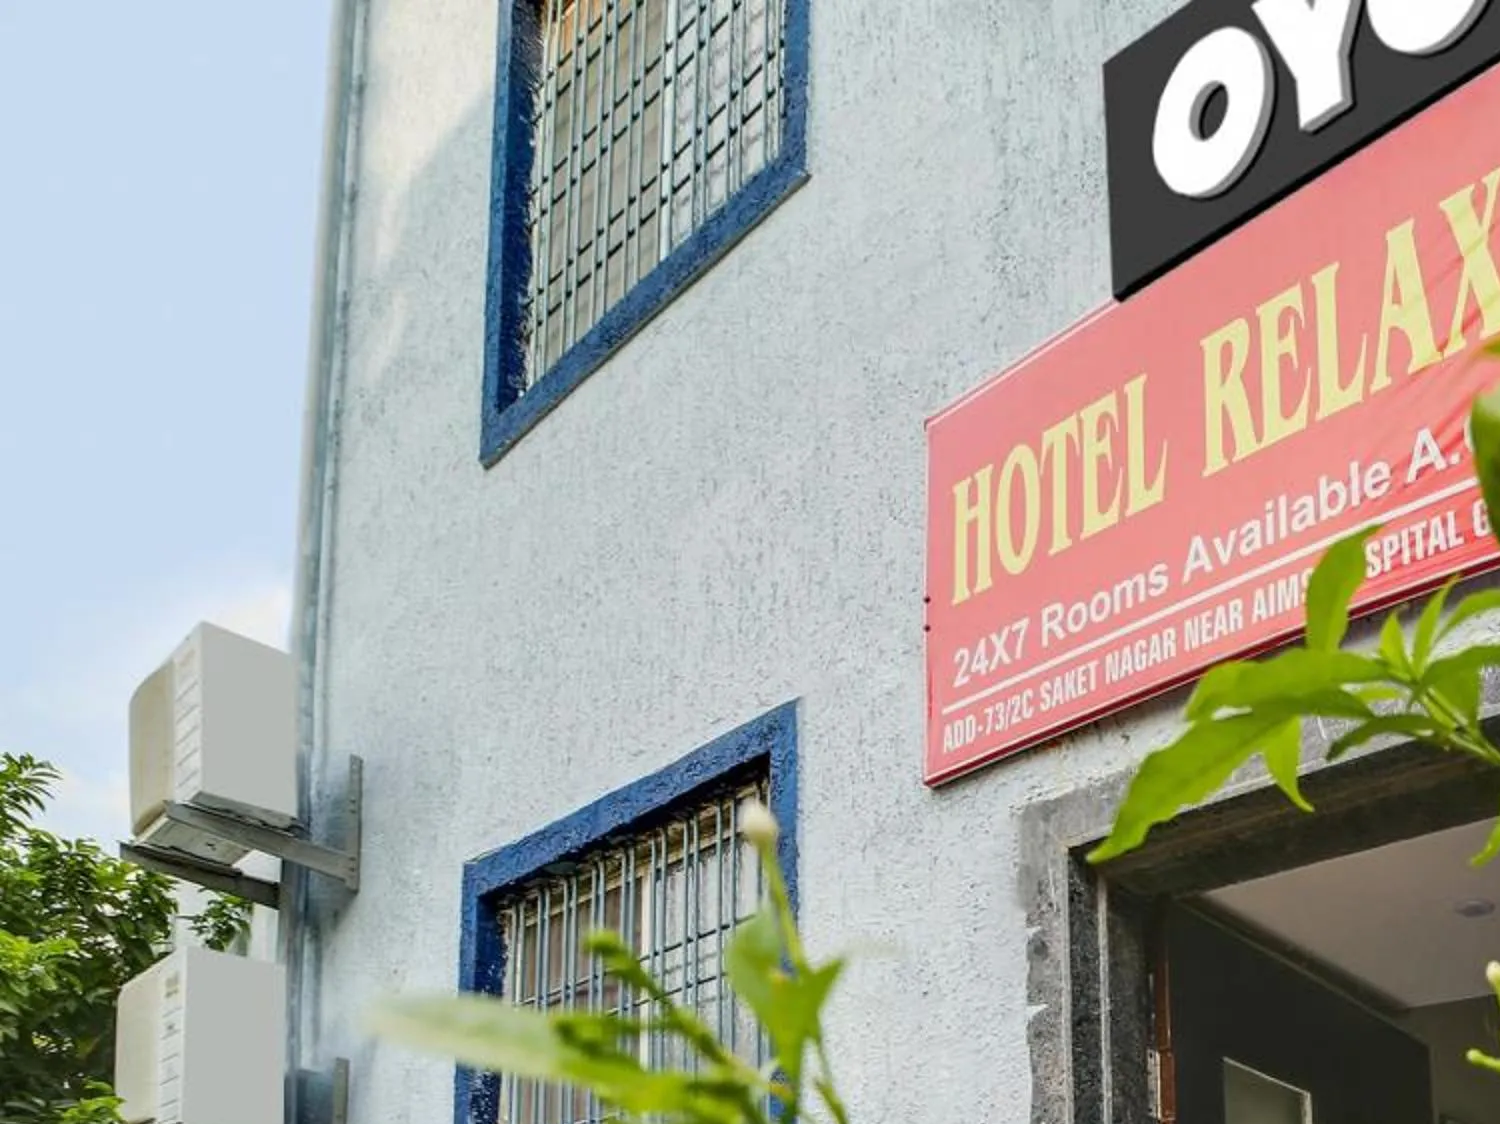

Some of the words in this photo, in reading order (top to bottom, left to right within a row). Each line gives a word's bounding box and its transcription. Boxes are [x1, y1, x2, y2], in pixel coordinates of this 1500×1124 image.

[952, 372, 1168, 605] HOTEL
[952, 616, 1030, 688] 24X7
[1040, 561, 1168, 649] Rooms
[1182, 459, 1392, 585] Available
[1039, 659, 1099, 712] SAKET
[1104, 626, 1177, 685] NAGAR
[1184, 597, 1244, 653] NEAR
[1363, 510, 1465, 579] SPITAL
